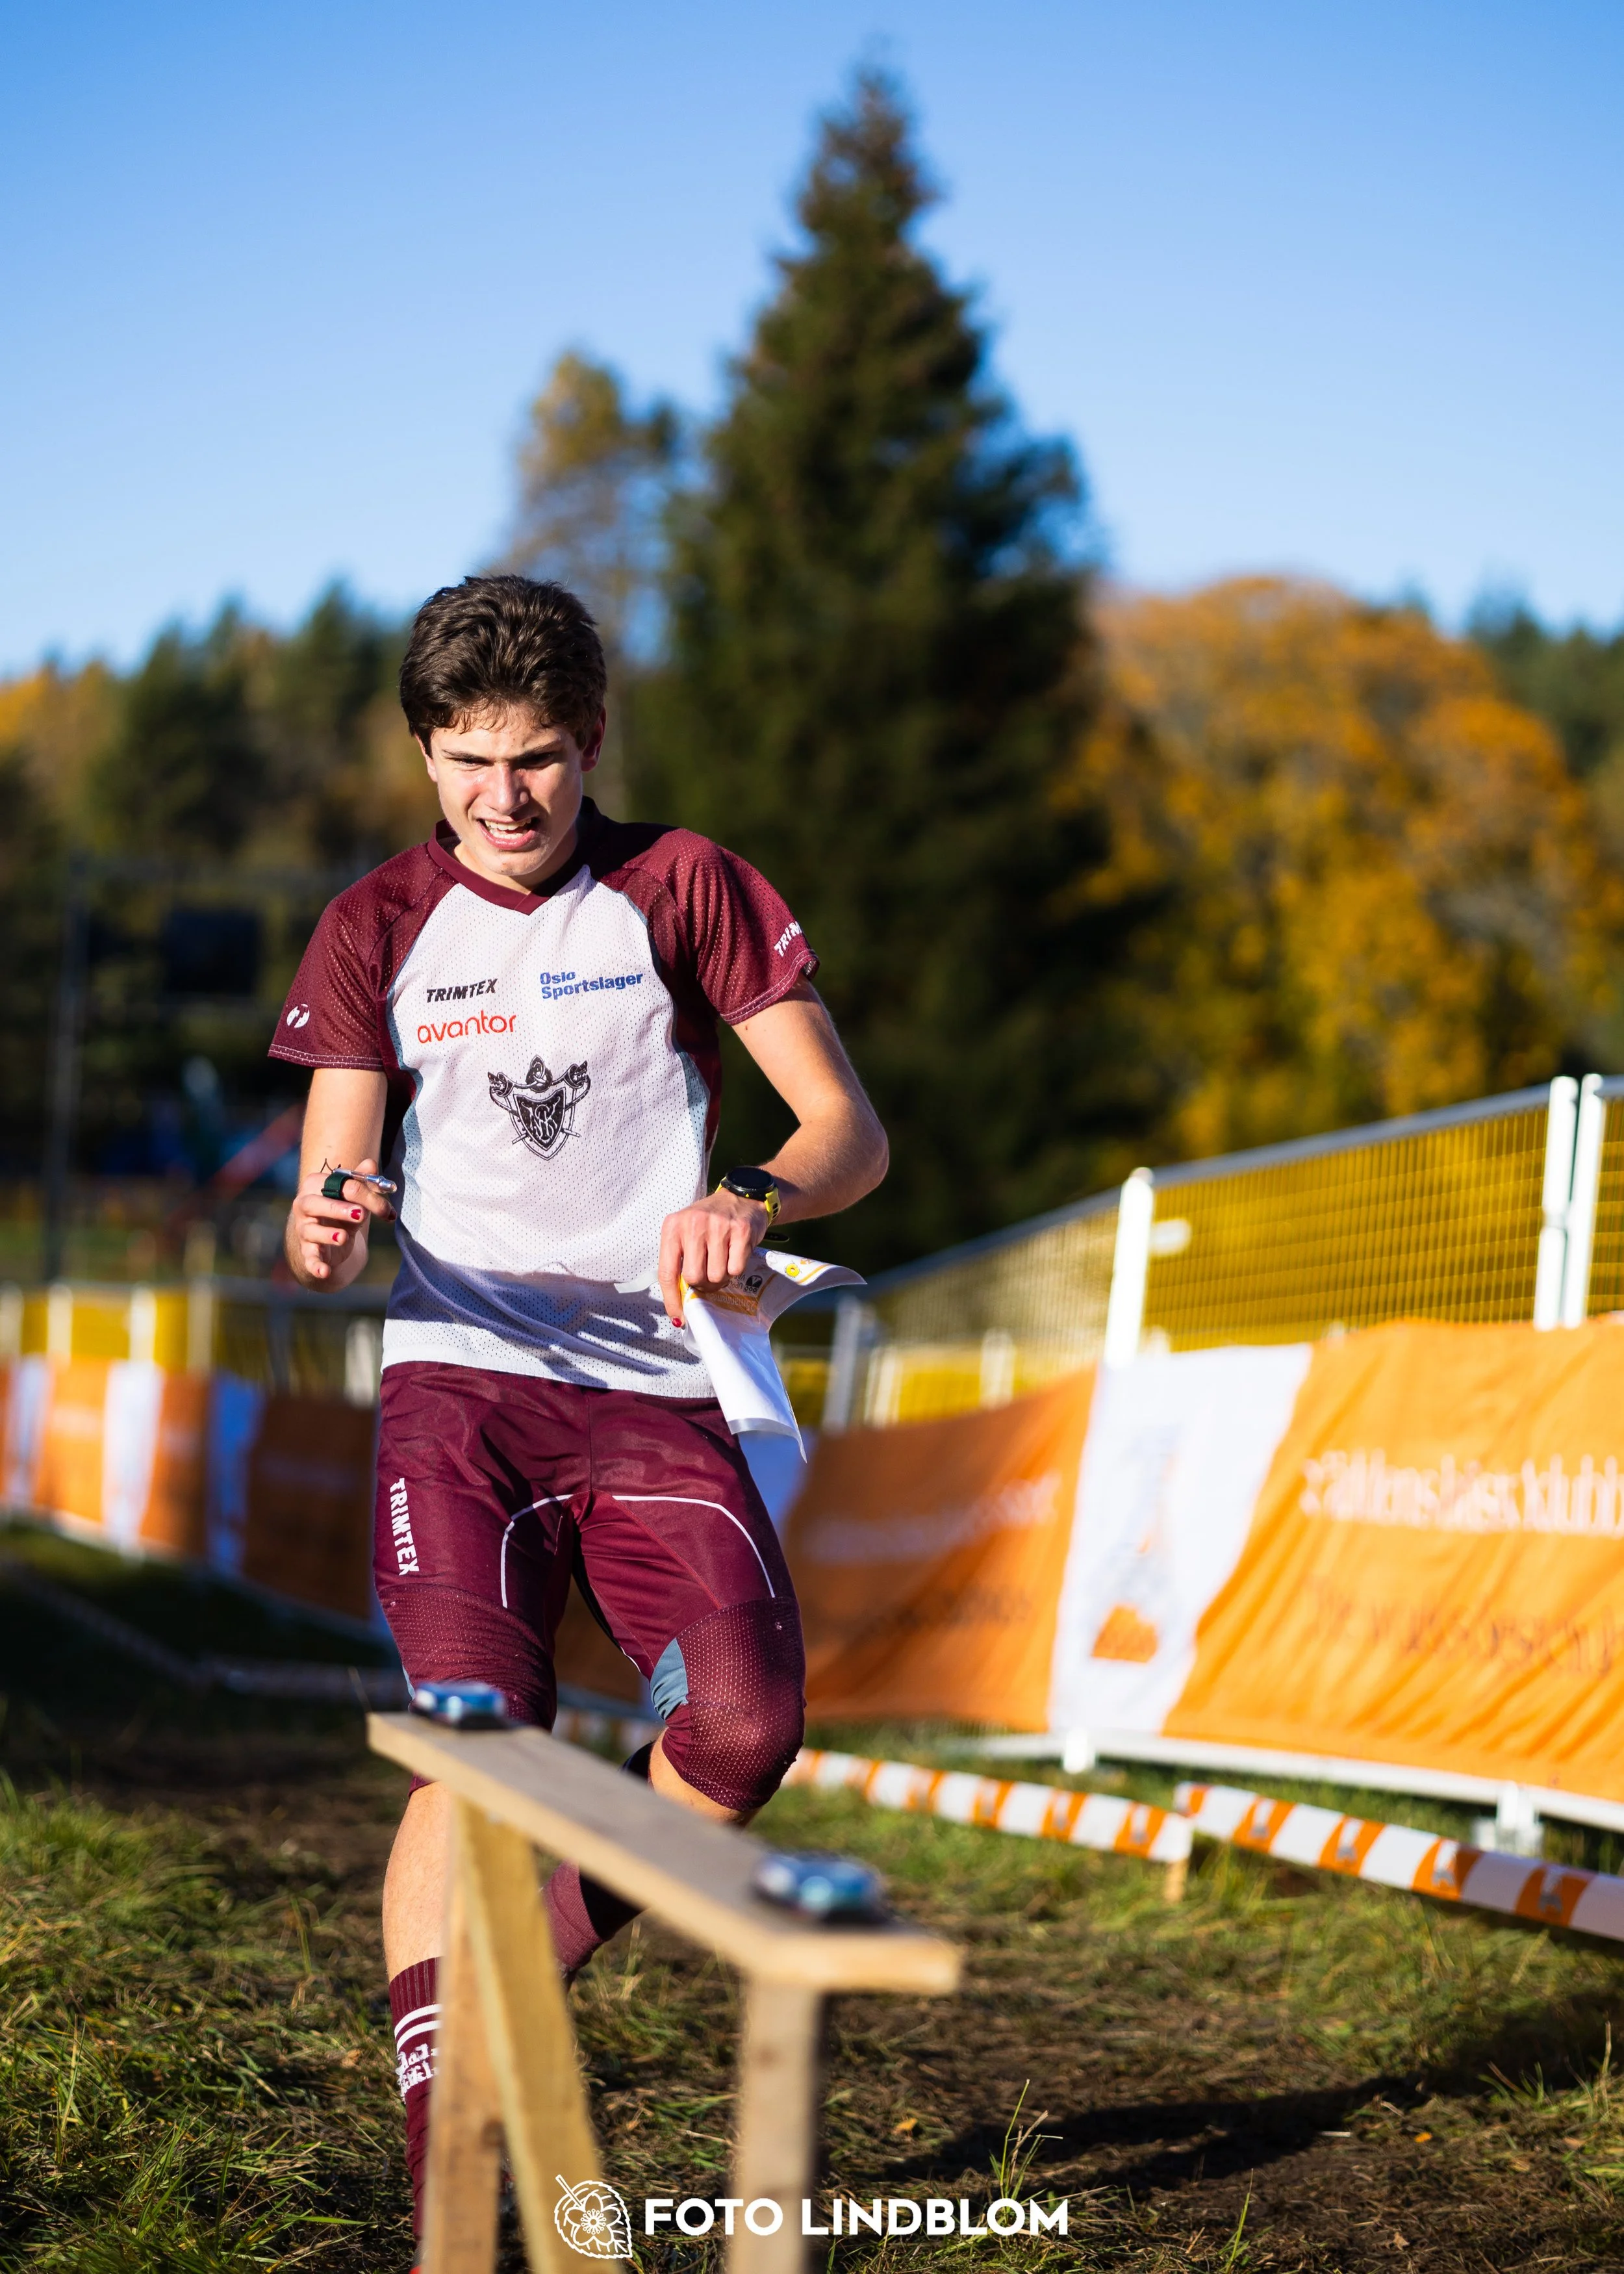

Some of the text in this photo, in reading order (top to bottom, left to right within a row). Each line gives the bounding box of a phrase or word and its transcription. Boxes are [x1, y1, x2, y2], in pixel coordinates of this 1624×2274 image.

[425, 978, 498, 1003] TRIMTEX
[539, 971, 576, 985] Oslo
[540, 973, 644, 1000] Sportslager
[416, 1010, 517, 1044] avantor
[390, 1477, 420, 1576] TRIMTEX
